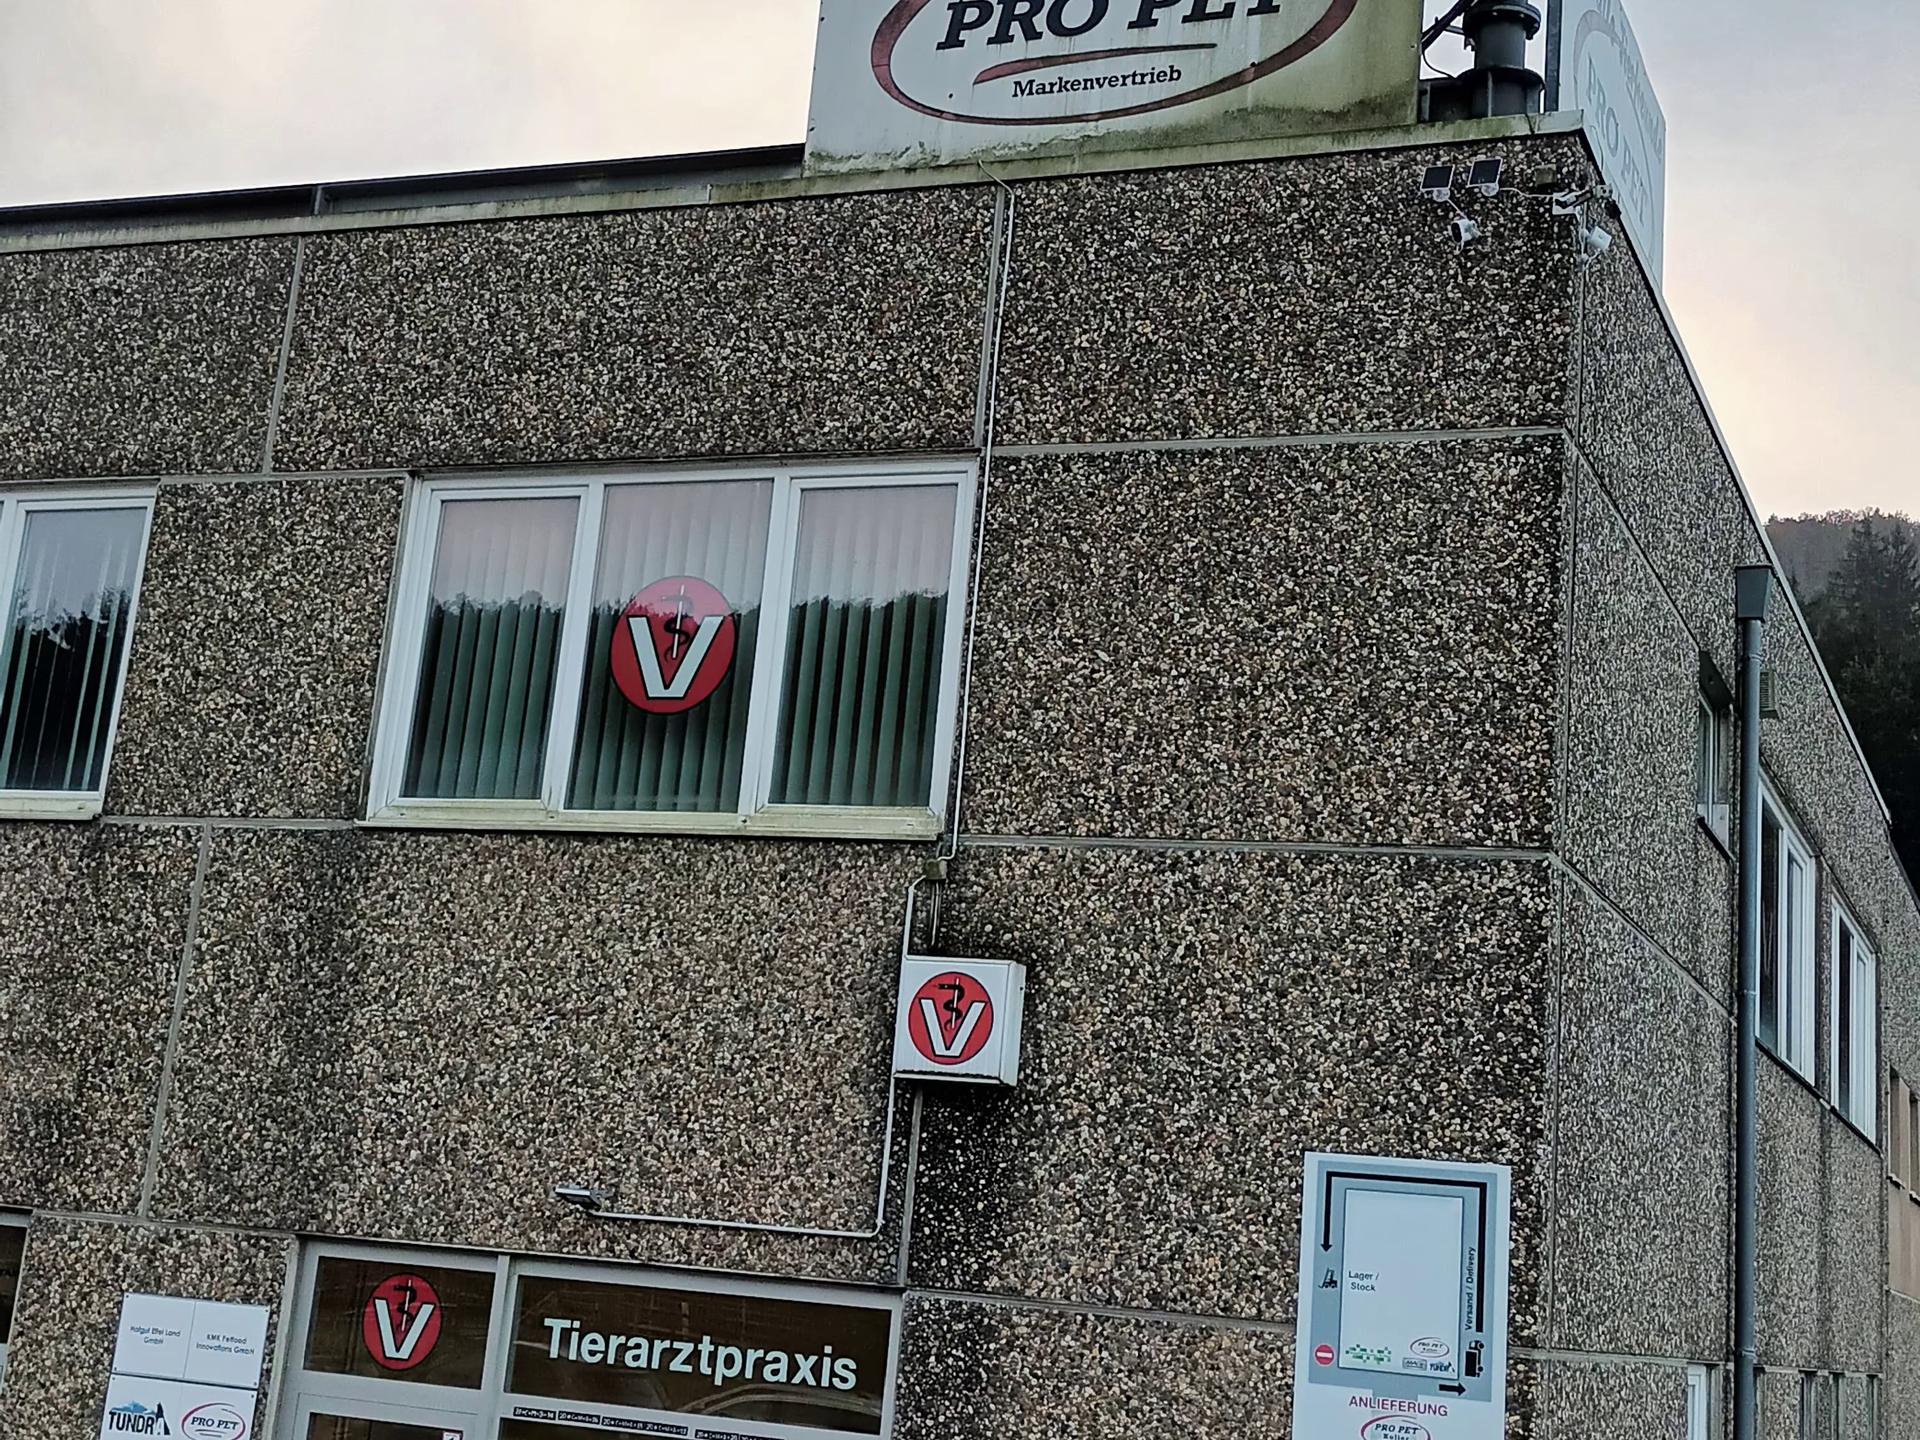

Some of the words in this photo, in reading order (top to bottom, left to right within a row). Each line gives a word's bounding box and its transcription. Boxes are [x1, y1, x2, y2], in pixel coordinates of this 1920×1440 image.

[936, 0, 1109, 50] PRO
[1011, 65, 1182, 98] Markenvertrieb
[1586, 52, 1619, 158] PRO
[1348, 1271, 1374, 1282] Lager
[1350, 1281, 1376, 1292] Stock
[1464, 1293, 1474, 1331] Versand
[543, 1317, 858, 1390] Tierarztpraxis
[108, 1402, 171, 1435] TUNDRA
[1348, 1395, 1448, 1417] ANLIEFERUNG
[190, 1416, 215, 1428] PRO
[216, 1419, 240, 1431] PET
[1374, 1423, 1396, 1432] PRO
[1397, 1425, 1421, 1435] PET
